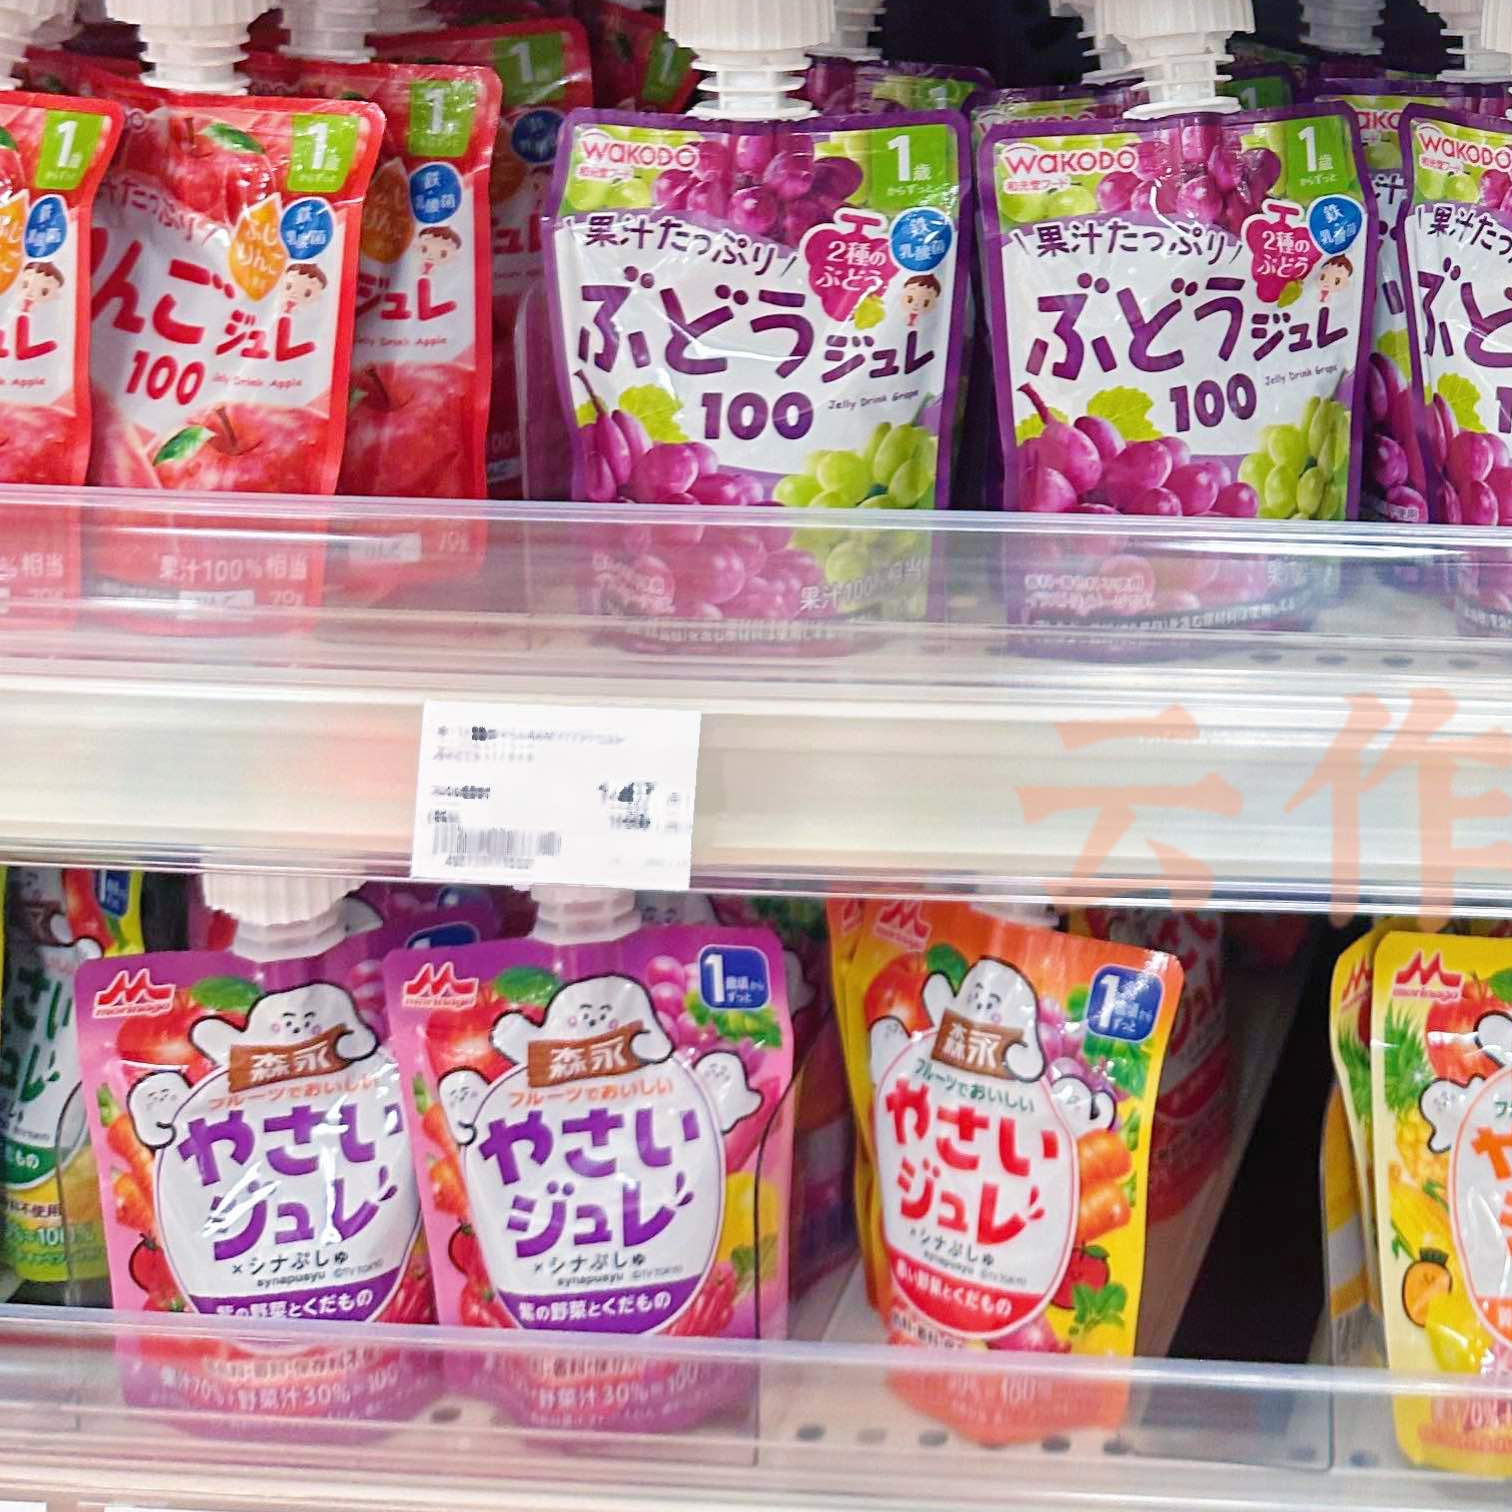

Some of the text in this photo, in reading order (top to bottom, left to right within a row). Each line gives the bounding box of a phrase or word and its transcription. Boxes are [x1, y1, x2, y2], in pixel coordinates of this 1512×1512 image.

[583, 214, 778, 277] 果汁たっぷり
[826, 241, 887, 267] 2種の
[1035, 220, 1231, 266] 果汁たっぷり
[1256, 251, 1309, 277] ぶどう
[1261, 232, 1309, 255] 2種の
[815, 265, 885, 290] ぶどう
[126, 349, 206, 406] 100
[701, 391, 814, 441] 100
[1170, 372, 1257, 433] 100
[250, 1043, 332, 1080] 森永
[548, 1040, 629, 1077] 森永
[941, 1025, 1005, 1069] 森永
[207, 1073, 379, 1111] フルーツでおいしい
[508, 1077, 675, 1110] フルーツでおいしい
[913, 1056, 1037, 1114] フルーツでおいしい
[478, 1106, 700, 1186] やさい
[886, 1076, 1058, 1176] やさい
[506, 1171, 695, 1261] ジュレ
[897, 1156, 1044, 1247] ジュレ
